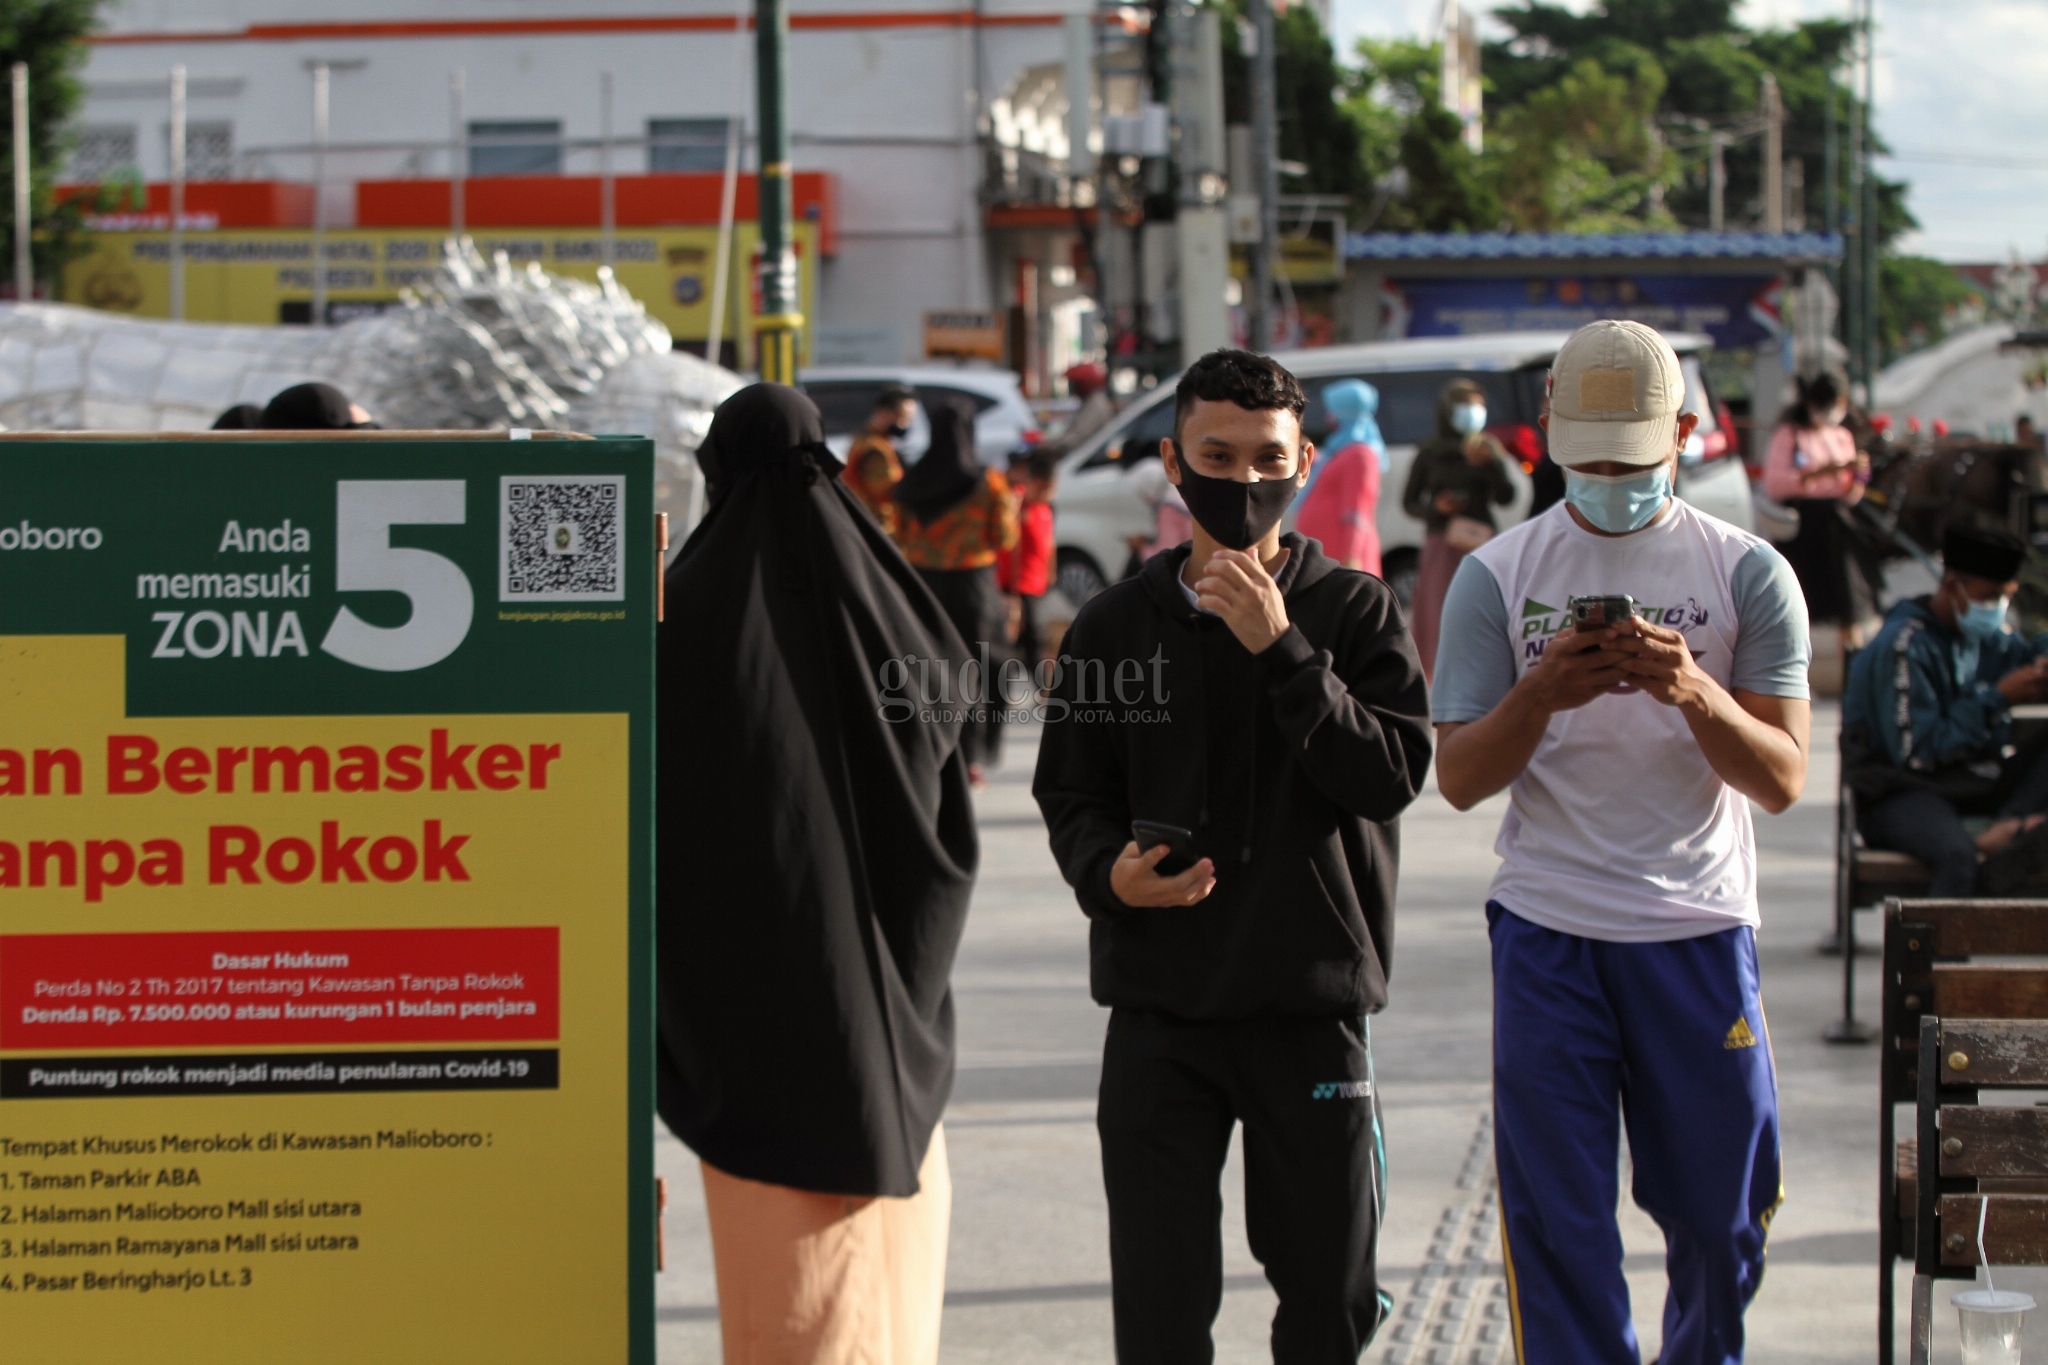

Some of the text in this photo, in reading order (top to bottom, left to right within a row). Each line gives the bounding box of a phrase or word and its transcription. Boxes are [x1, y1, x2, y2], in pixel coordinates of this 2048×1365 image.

[219, 519, 311, 552] Anda
[137, 565, 310, 598] memasuki
[320, 479, 474, 672] 5
[152, 611, 309, 658] ZONA
[106, 728, 562, 795] Bermasker
[208, 819, 471, 885] Rokok
[212, 953, 349, 970] Dasar Hukum
[34, 972, 524, 997] Perda No 2 Th 2017 tentang Kawasan Tanpa Rokok
[22, 997, 537, 1026] Denda Rp. 7.500.000 atau kurungan 1 bulan penjara
[29, 1059, 530, 1089] Puntung rokok menjadi media penularan Covid-19
[1, 1137, 78, 1159] Tempat
[82, 1136, 157, 1154] Khusus
[161, 1133, 253, 1153] Merokok
[258, 1132, 277, 1151] di
[282, 1132, 371, 1150] Kawasan
[376, 1129, 483, 1148] Malioboro
[0, 1168, 201, 1190] 1. Taman Parkir ABA
[0, 1198, 362, 1224] 2. Halaman Malioboro Mall sisi utara
[0, 1232, 359, 1258] 3. Halaman Ramayana Mall sisi utara
[0, 1267, 253, 1292] 4. Pasar Beringharjo Lt. 3
